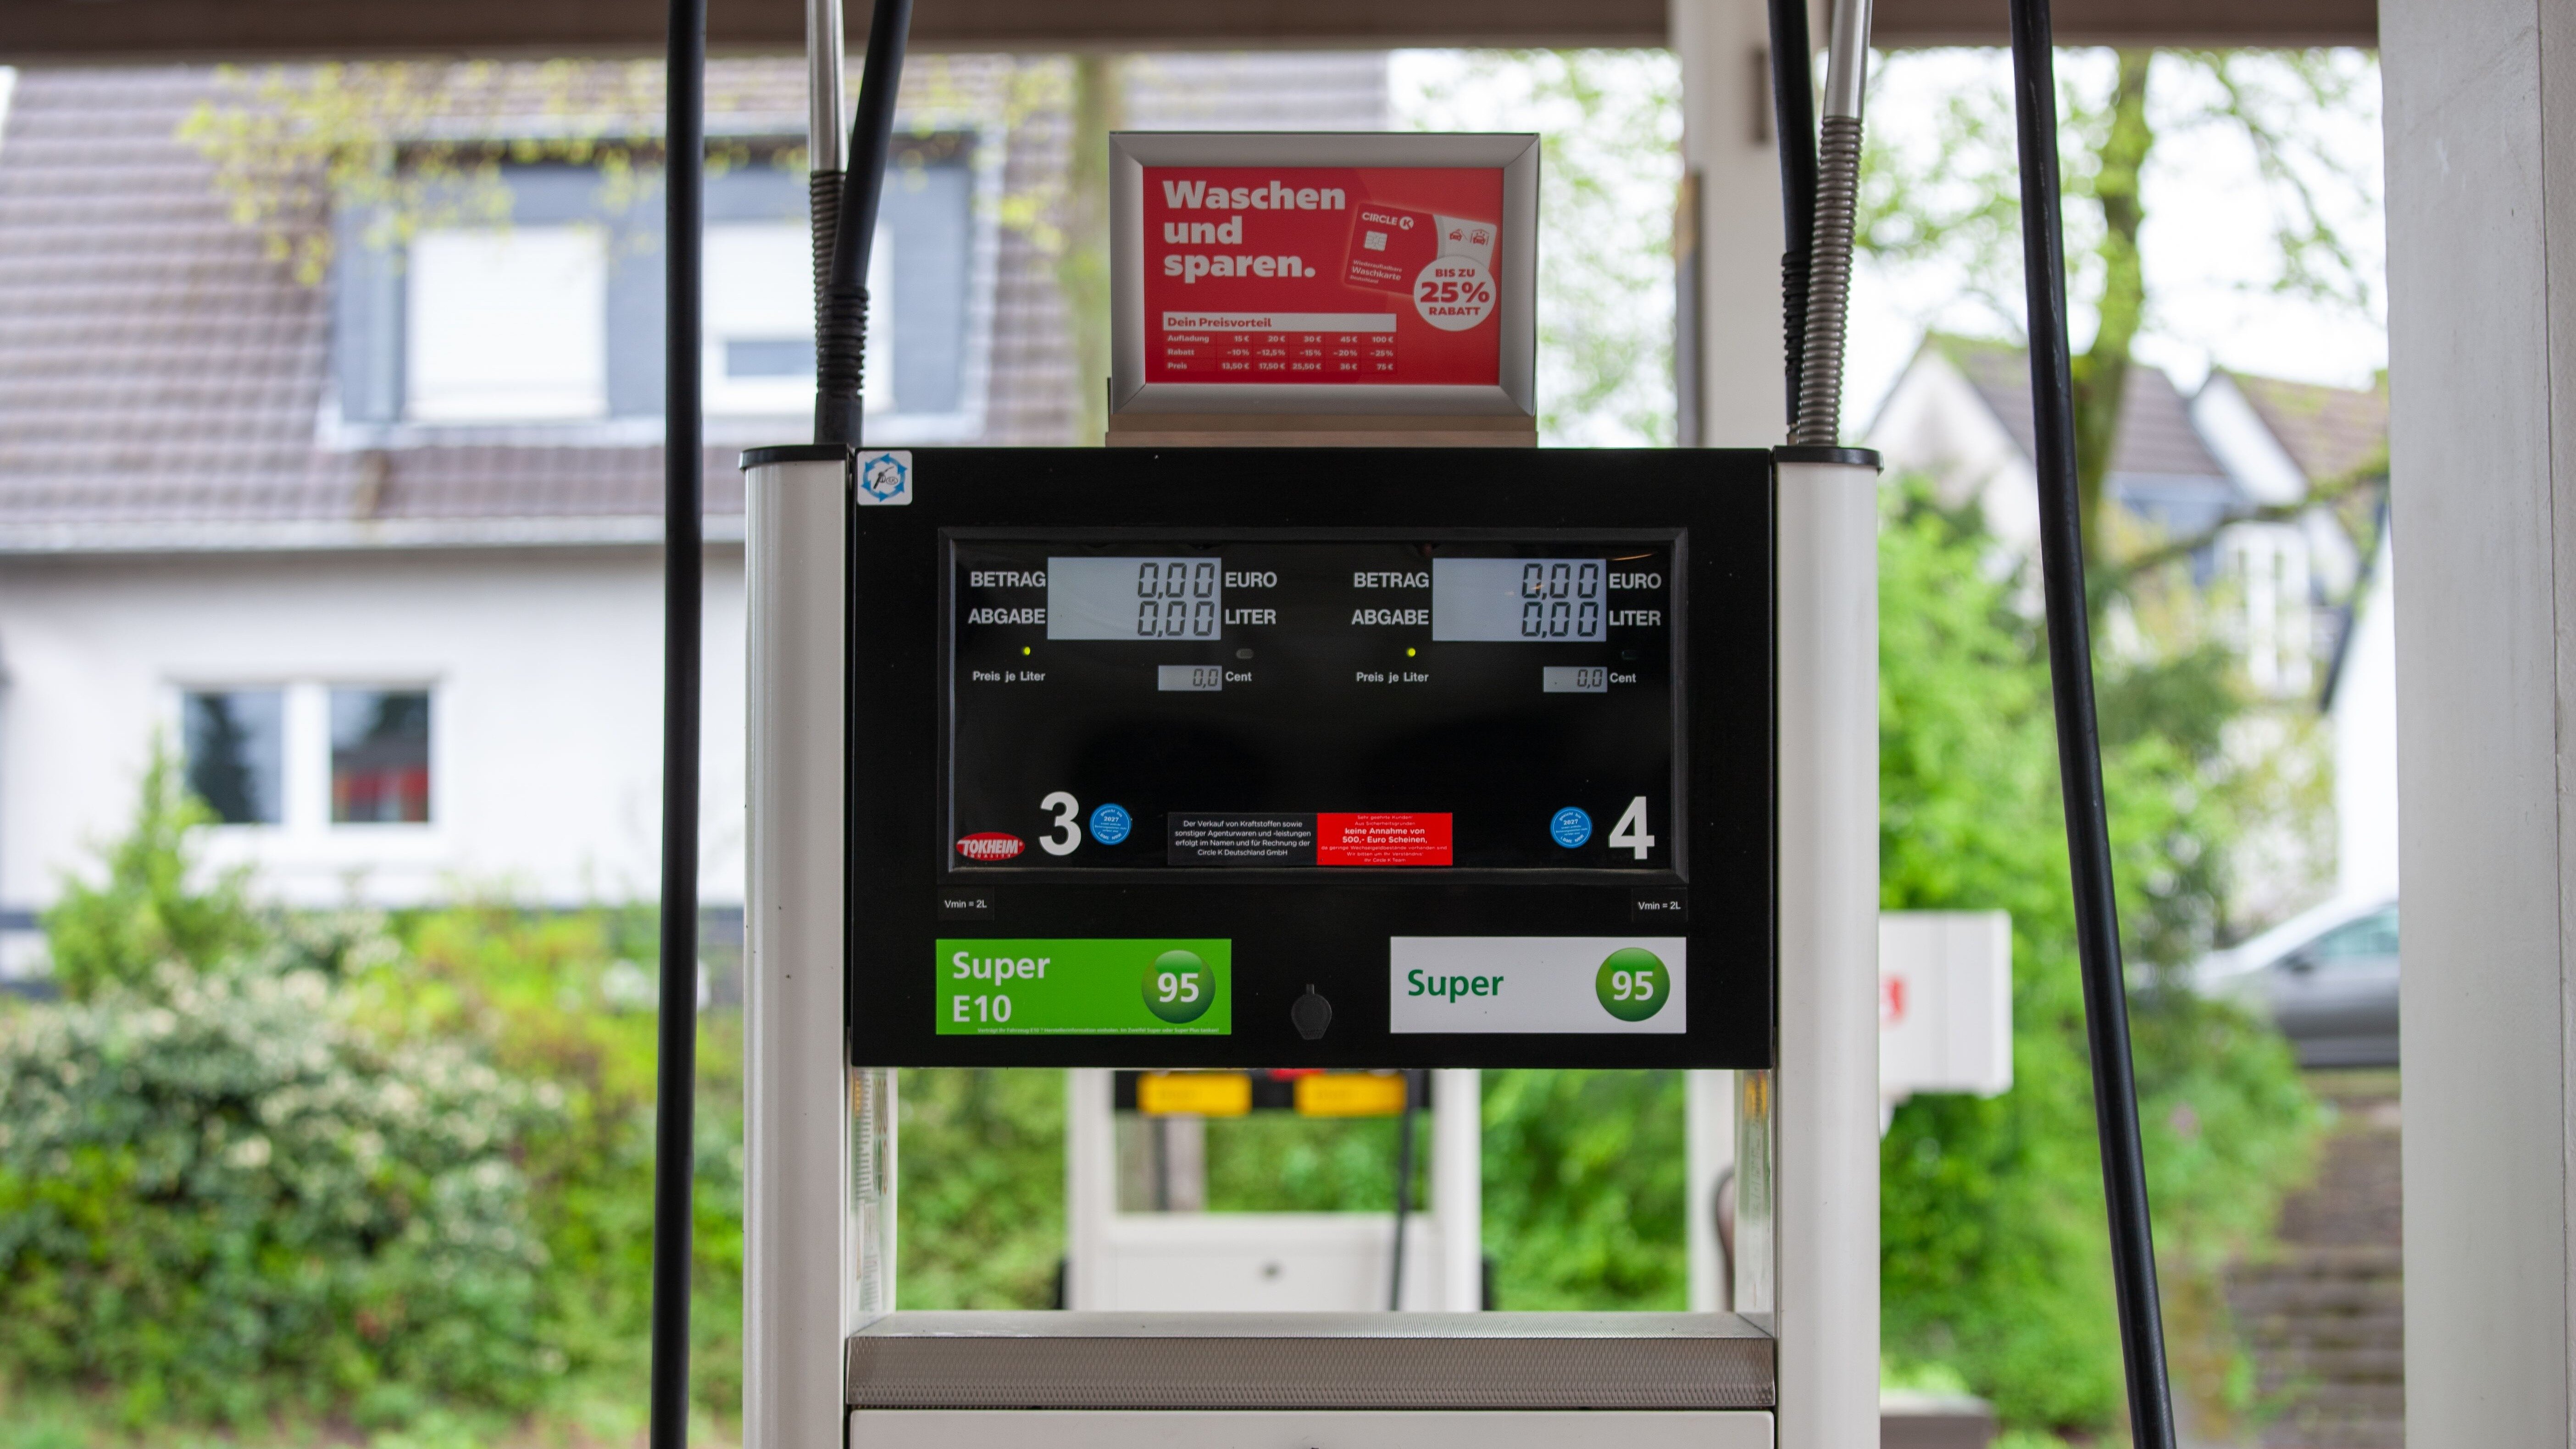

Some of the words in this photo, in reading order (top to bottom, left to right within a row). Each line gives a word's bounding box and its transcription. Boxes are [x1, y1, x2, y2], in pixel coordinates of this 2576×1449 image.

[1162, 180, 1345, 210] Waschen
[1164, 215, 1242, 244] und
[1362, 211, 1398, 226] CIRCLE
[1401, 217, 1414, 229] K
[1164, 254, 1316, 284] sparen.
[1352, 266, 1401, 281] Waschkarte
[1354, 260, 1402, 272] Wiederaufladbare
[1435, 268, 1455, 278] BIS
[1458, 268, 1475, 278] ZU
[1350, 275, 1379, 283] Deutschland
[1420, 281, 1490, 303] 25%
[1168, 317, 1196, 327] Dein
[1199, 317, 1272, 328] Preisvorteil
[1429, 306, 1481, 316] RABATT
[1168, 335, 1209, 343] Aufladung
[971, 572, 1046, 588] BETRAG
[1138, 562, 1216, 599] 0,00
[1225, 572, 1277, 588] EURO
[1354, 572, 1429, 588] BETRAG
[1521, 563, 1599, 600] 0,00
[1610, 573, 1662, 589] EURO
[968, 609, 1046, 625] ABGABE
[1138, 600, 1216, 638] 0,00
[1225, 609, 1277, 625] LITER
[1352, 610, 1429, 625] ABGABE
[1521, 601, 1599, 638] 0,00
[1610, 611, 1661, 626] LITER
[972, 671, 1000, 682] Preis
[1005, 671, 1016, 683] je
[1020, 671, 1045, 682] Liter
[1193, 668, 1218, 688] 0,0
[1225, 672, 1252, 682] Cent
[1356, 672, 1384, 682] Preis
[1388, 672, 1399, 684] je
[1404, 672, 1429, 682] Liter
[1577, 669, 1603, 688] 0,0
[1610, 672, 1636, 683] Cent
[1038, 791, 1082, 856] 3
[1608, 796, 1655, 860] 4
[957, 839, 1018, 855] TOKHEIM
[944, 899, 966, 908] Vmin
[977, 899, 987, 908] 2L
[1638, 901, 1660, 910] Vmin
[1670, 901, 1681, 910] 2L
[952, 951, 1050, 987] Super
[1157, 972, 1199, 1003] 95
[1407, 969, 1504, 1004] Super
[1612, 971, 1654, 1001] 95
[953, 994, 1012, 1023] E10
